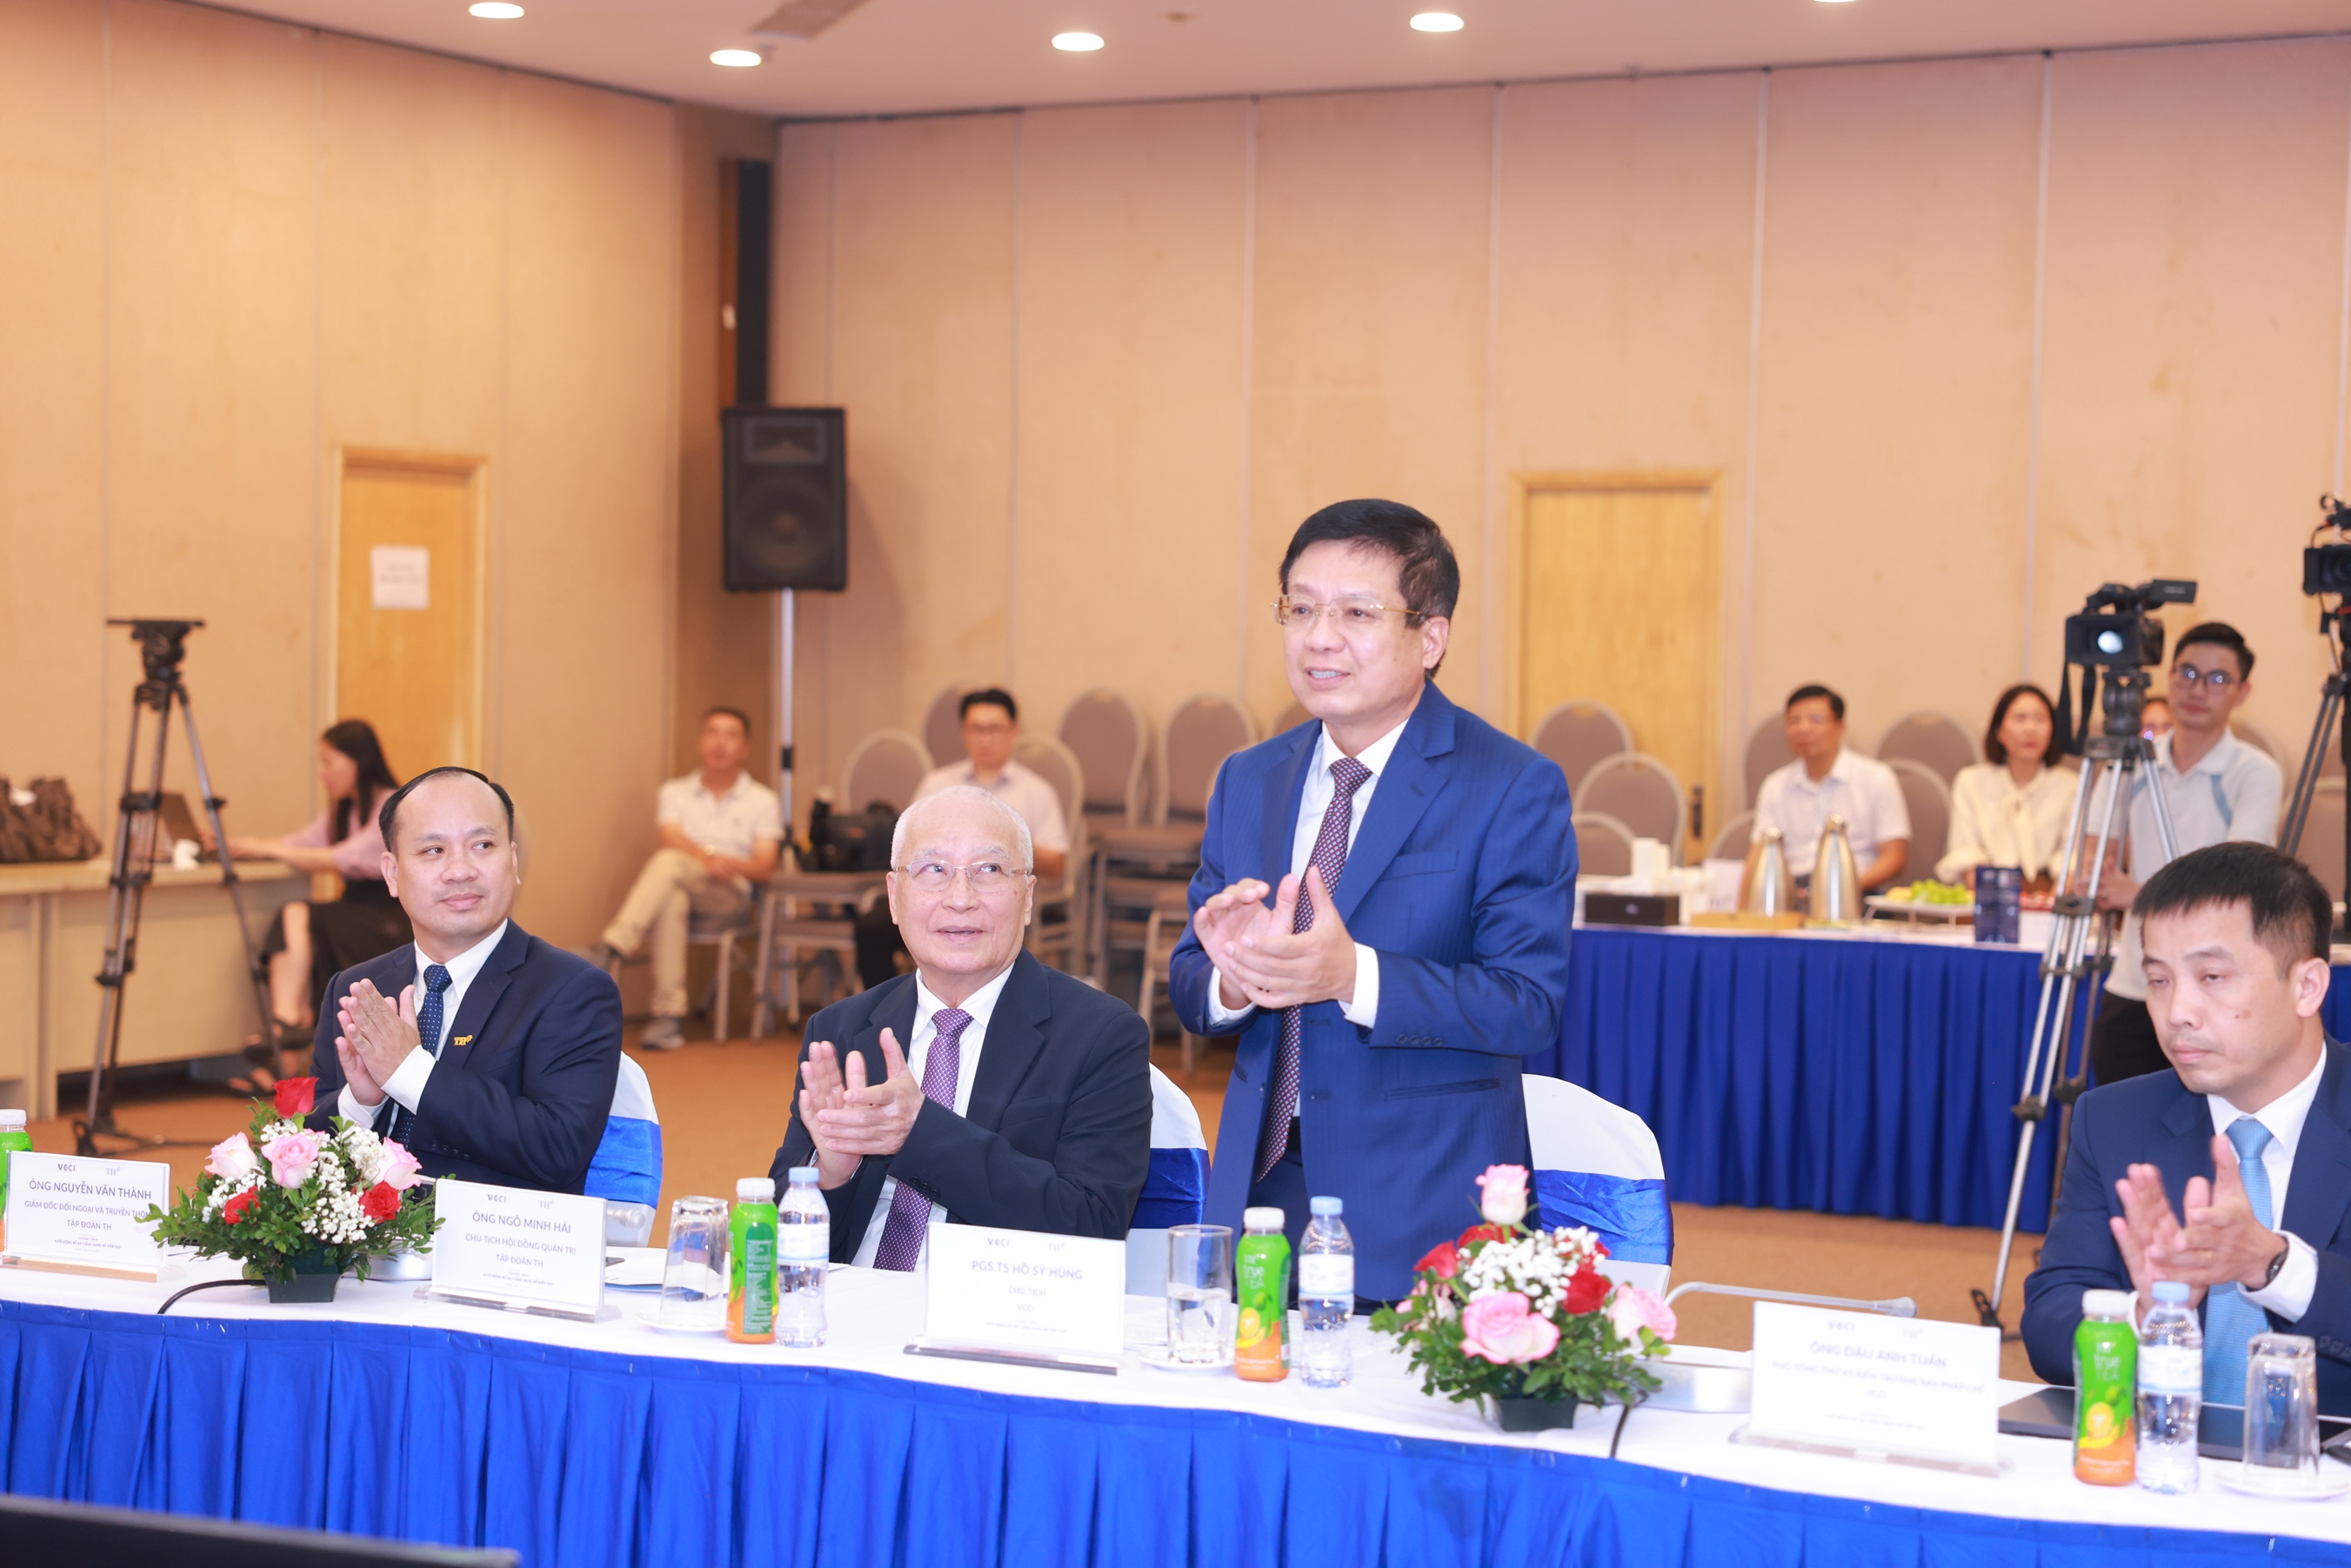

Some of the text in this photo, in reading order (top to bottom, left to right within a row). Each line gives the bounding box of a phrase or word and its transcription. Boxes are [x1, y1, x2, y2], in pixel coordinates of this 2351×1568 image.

[29, 1178, 151, 1200] ÔNG NGUYỄN VĂN THÀNH
[24, 1199, 42, 1209] GIÁM
[43, 1201, 57, 1210] ĐỐC
[59, 1202, 71, 1211] ĐỐI
[72, 1205, 94, 1214] NGOẠI
[95, 1205, 104, 1214] VÀ
[105, 1206, 130, 1217] TRUYỀN
[66, 1218, 112, 1231] TẬP ĐOÀN TH
[472, 1210, 571, 1234] ÔNG NGÔ MINH HẢI
[465, 1232, 576, 1257] CHỦ TỊCH HỘI ĐỒNG QUẢN TRỊ
[496, 1253, 510, 1264] TẬP
[511, 1256, 531, 1265] ĐOÀN
[972, 1260, 1010, 1273] PGS.TS
[1012, 1261, 1030, 1275] HỒ
[1049, 1264, 1083, 1280] HÙNG
[1008, 1284, 1045, 1297] CHỦ TỊCH
[1017, 1304, 1034, 1312] VCCI
[1809, 1339, 1841, 1356] ÔNG
[1877, 1350, 1907, 1364] ANH
